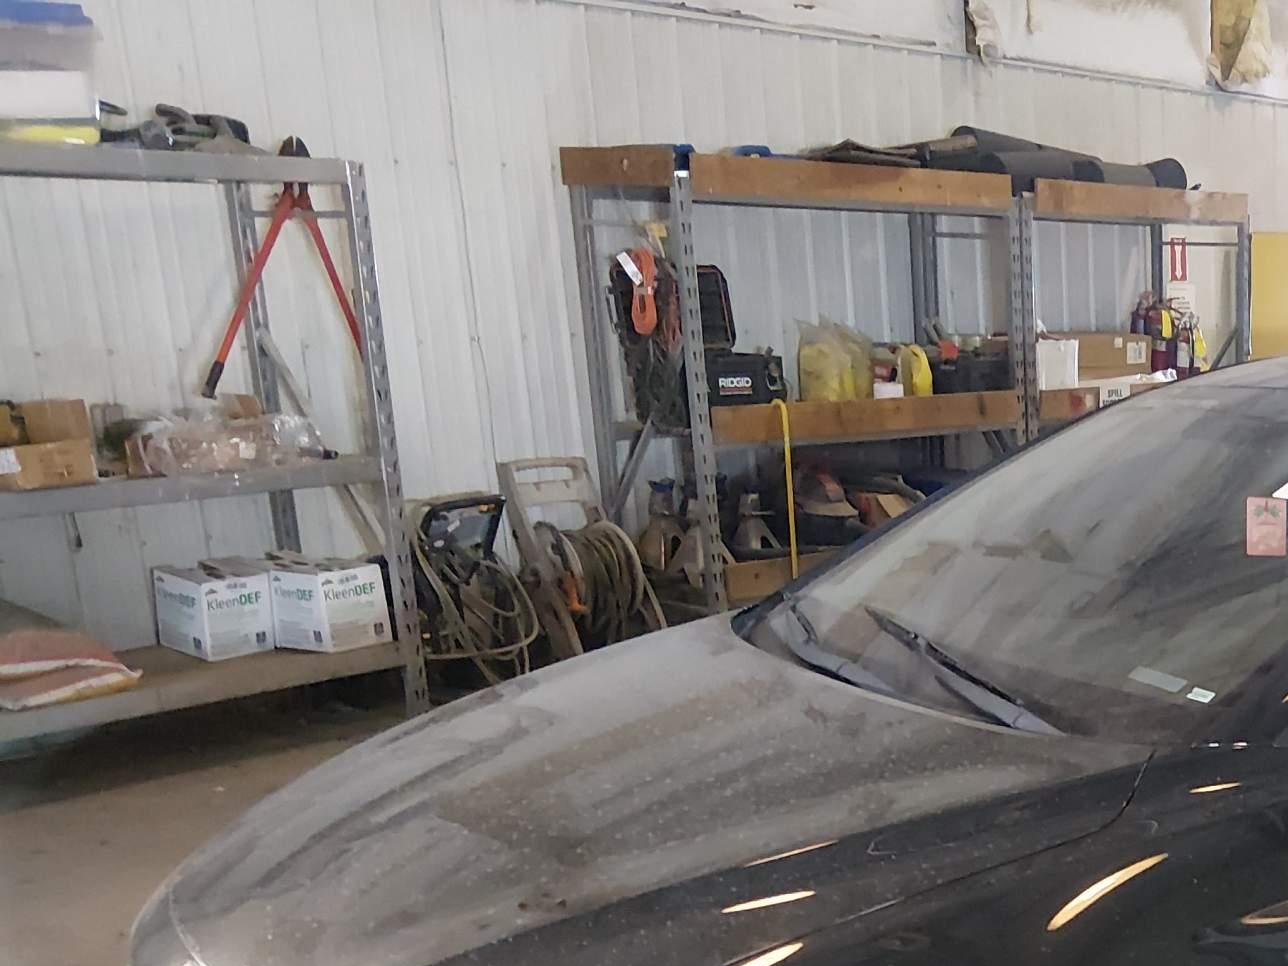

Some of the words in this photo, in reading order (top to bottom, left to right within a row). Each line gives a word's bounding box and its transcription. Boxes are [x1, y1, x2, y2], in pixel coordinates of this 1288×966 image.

[718, 377, 752, 388] RIDGID
[206, 590, 262, 611] KleenDEF
[323, 581, 377, 602] KleenDEF
